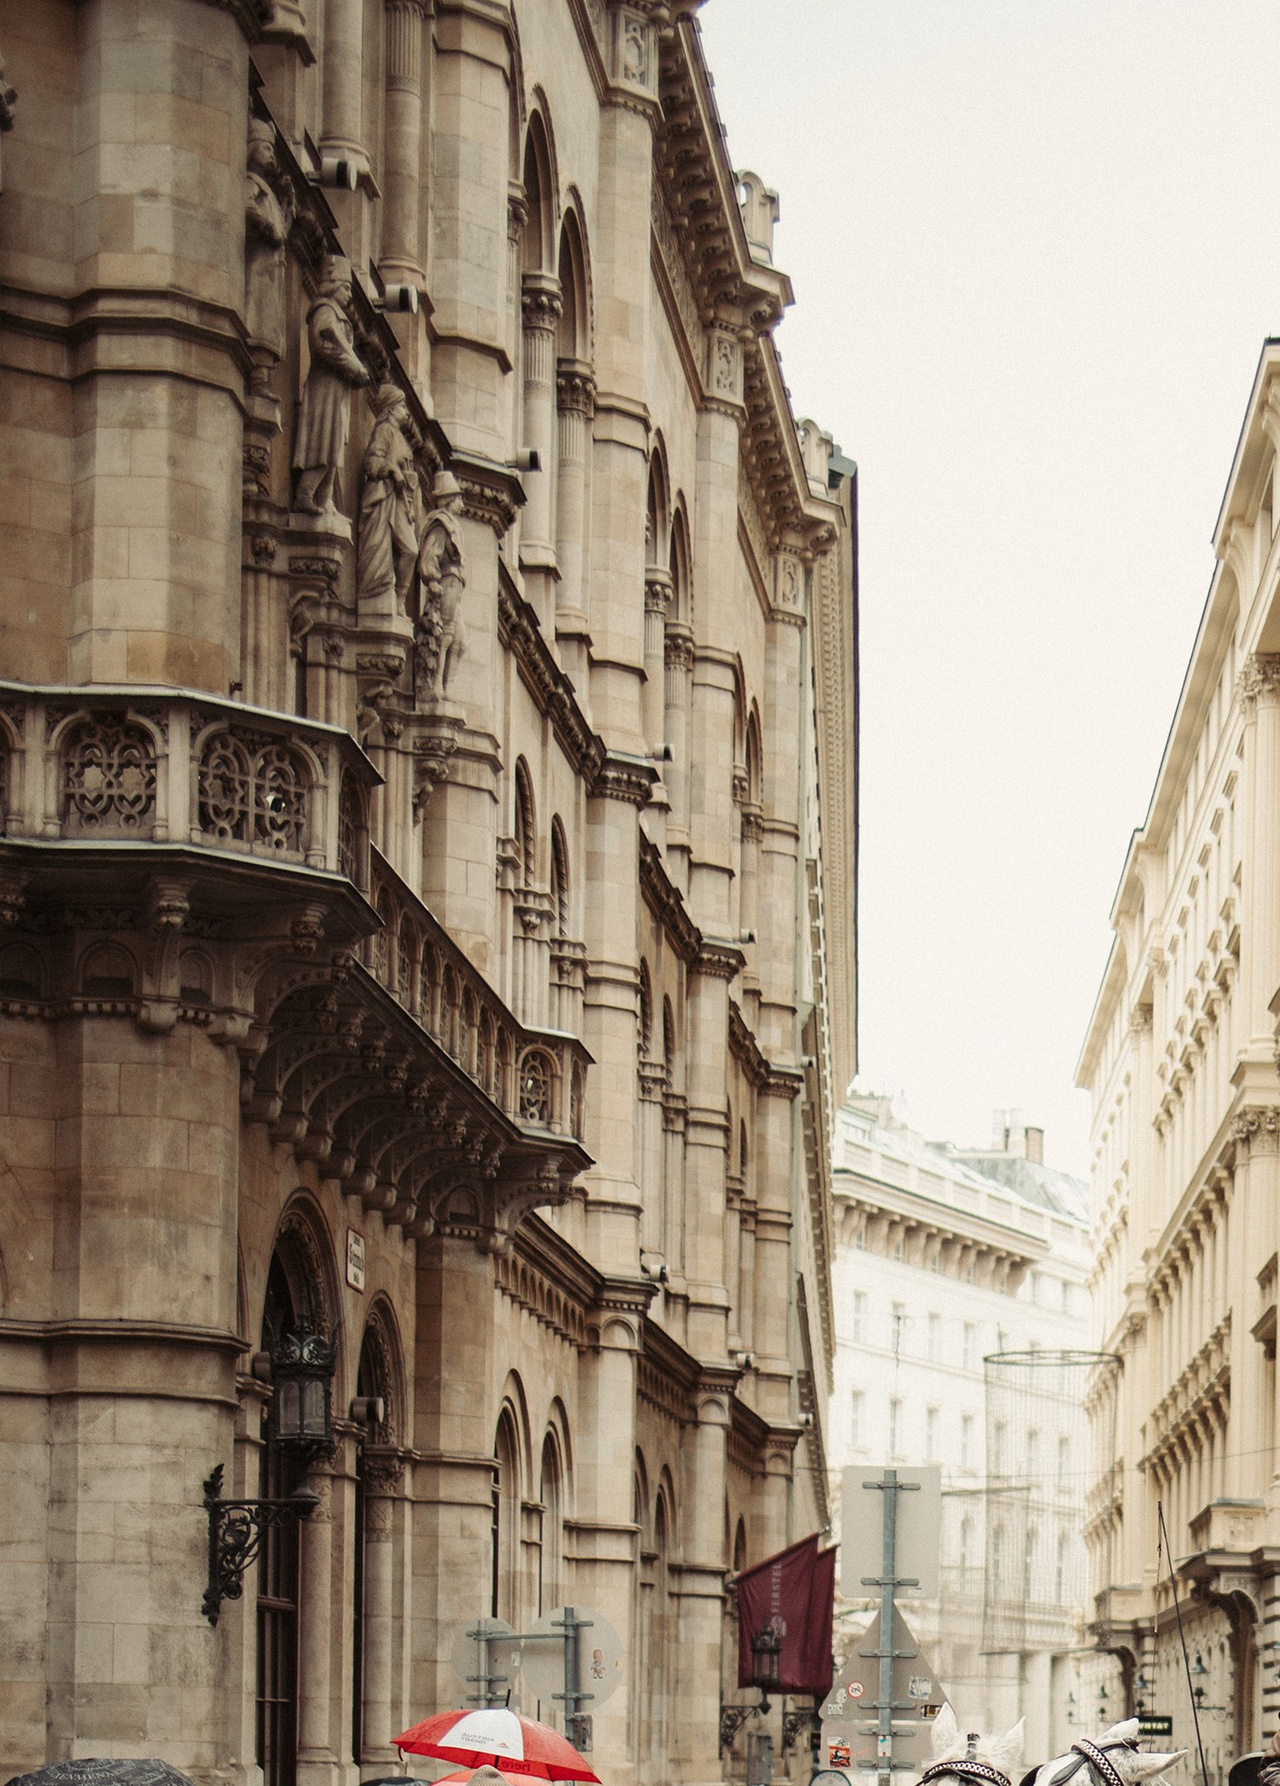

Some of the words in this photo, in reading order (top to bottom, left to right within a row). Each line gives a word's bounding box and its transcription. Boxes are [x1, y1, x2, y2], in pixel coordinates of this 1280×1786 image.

[771, 1562, 782, 1613] FERSTEL
[461, 1732, 495, 1742] AUSTRIA
[461, 1736, 487, 1744] TREND
